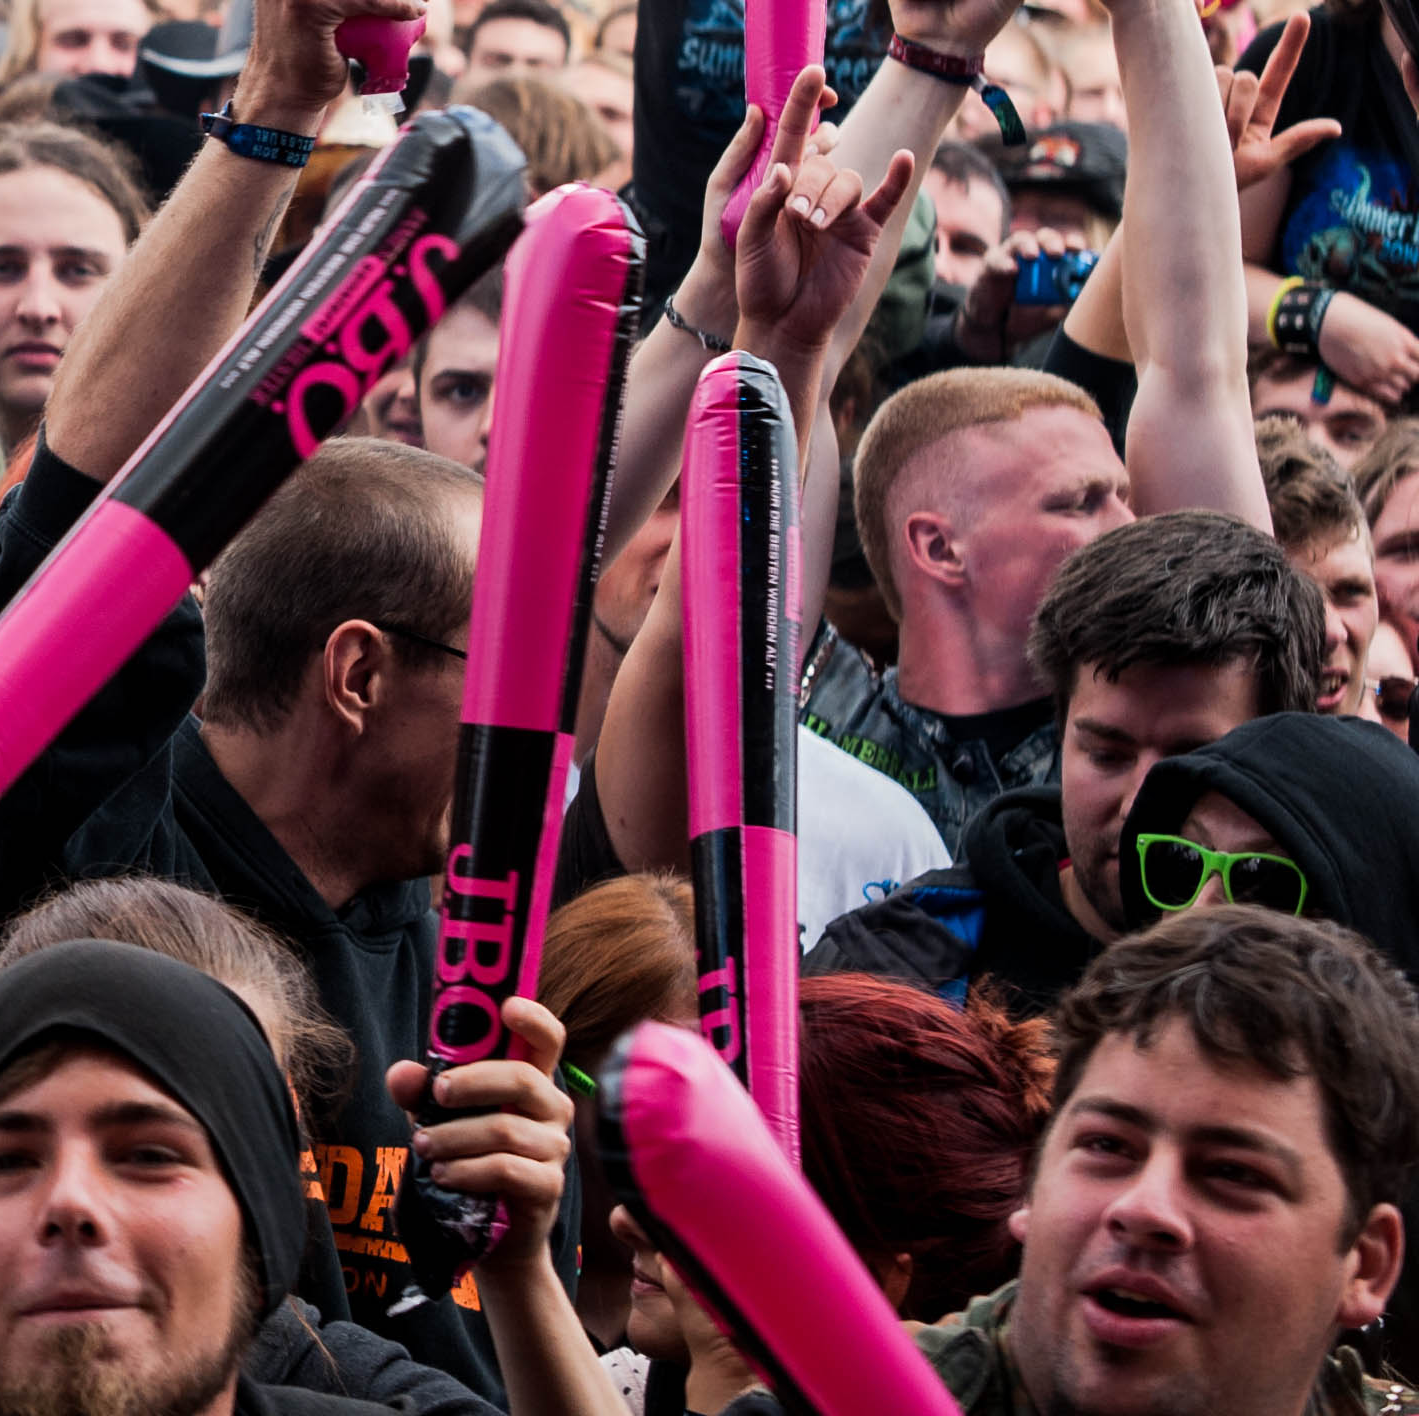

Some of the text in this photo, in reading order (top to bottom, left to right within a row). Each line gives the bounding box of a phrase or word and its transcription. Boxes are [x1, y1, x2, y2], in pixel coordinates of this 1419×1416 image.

[765, 479, 781, 670] NUR DIE BESTEN WERDEN ALT
